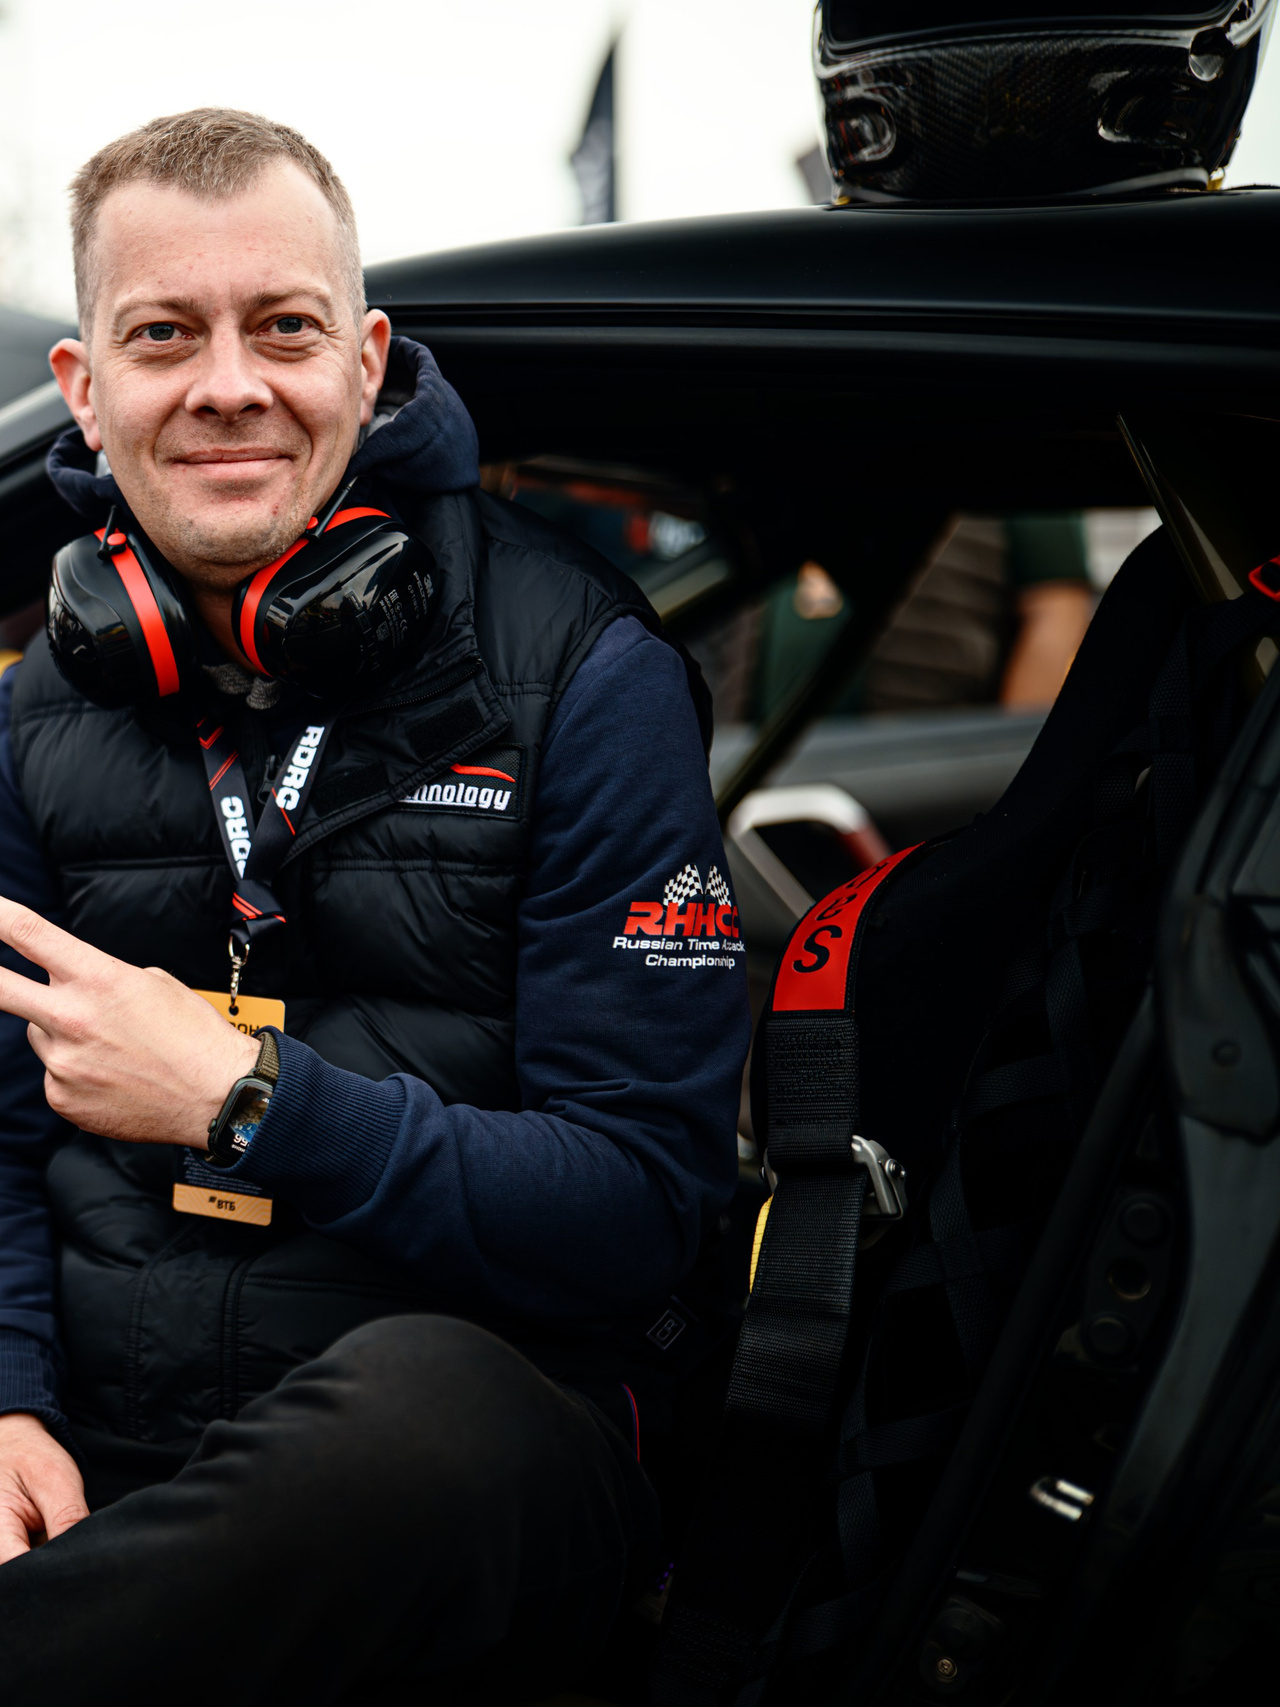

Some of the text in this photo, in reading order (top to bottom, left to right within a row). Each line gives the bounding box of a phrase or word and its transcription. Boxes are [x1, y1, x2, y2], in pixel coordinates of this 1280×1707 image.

[275, 725, 326, 811] RDRC
[405, 783, 512, 811] hnology
[613, 937, 683, 950] Russian
[687, 938, 720, 951] Time
